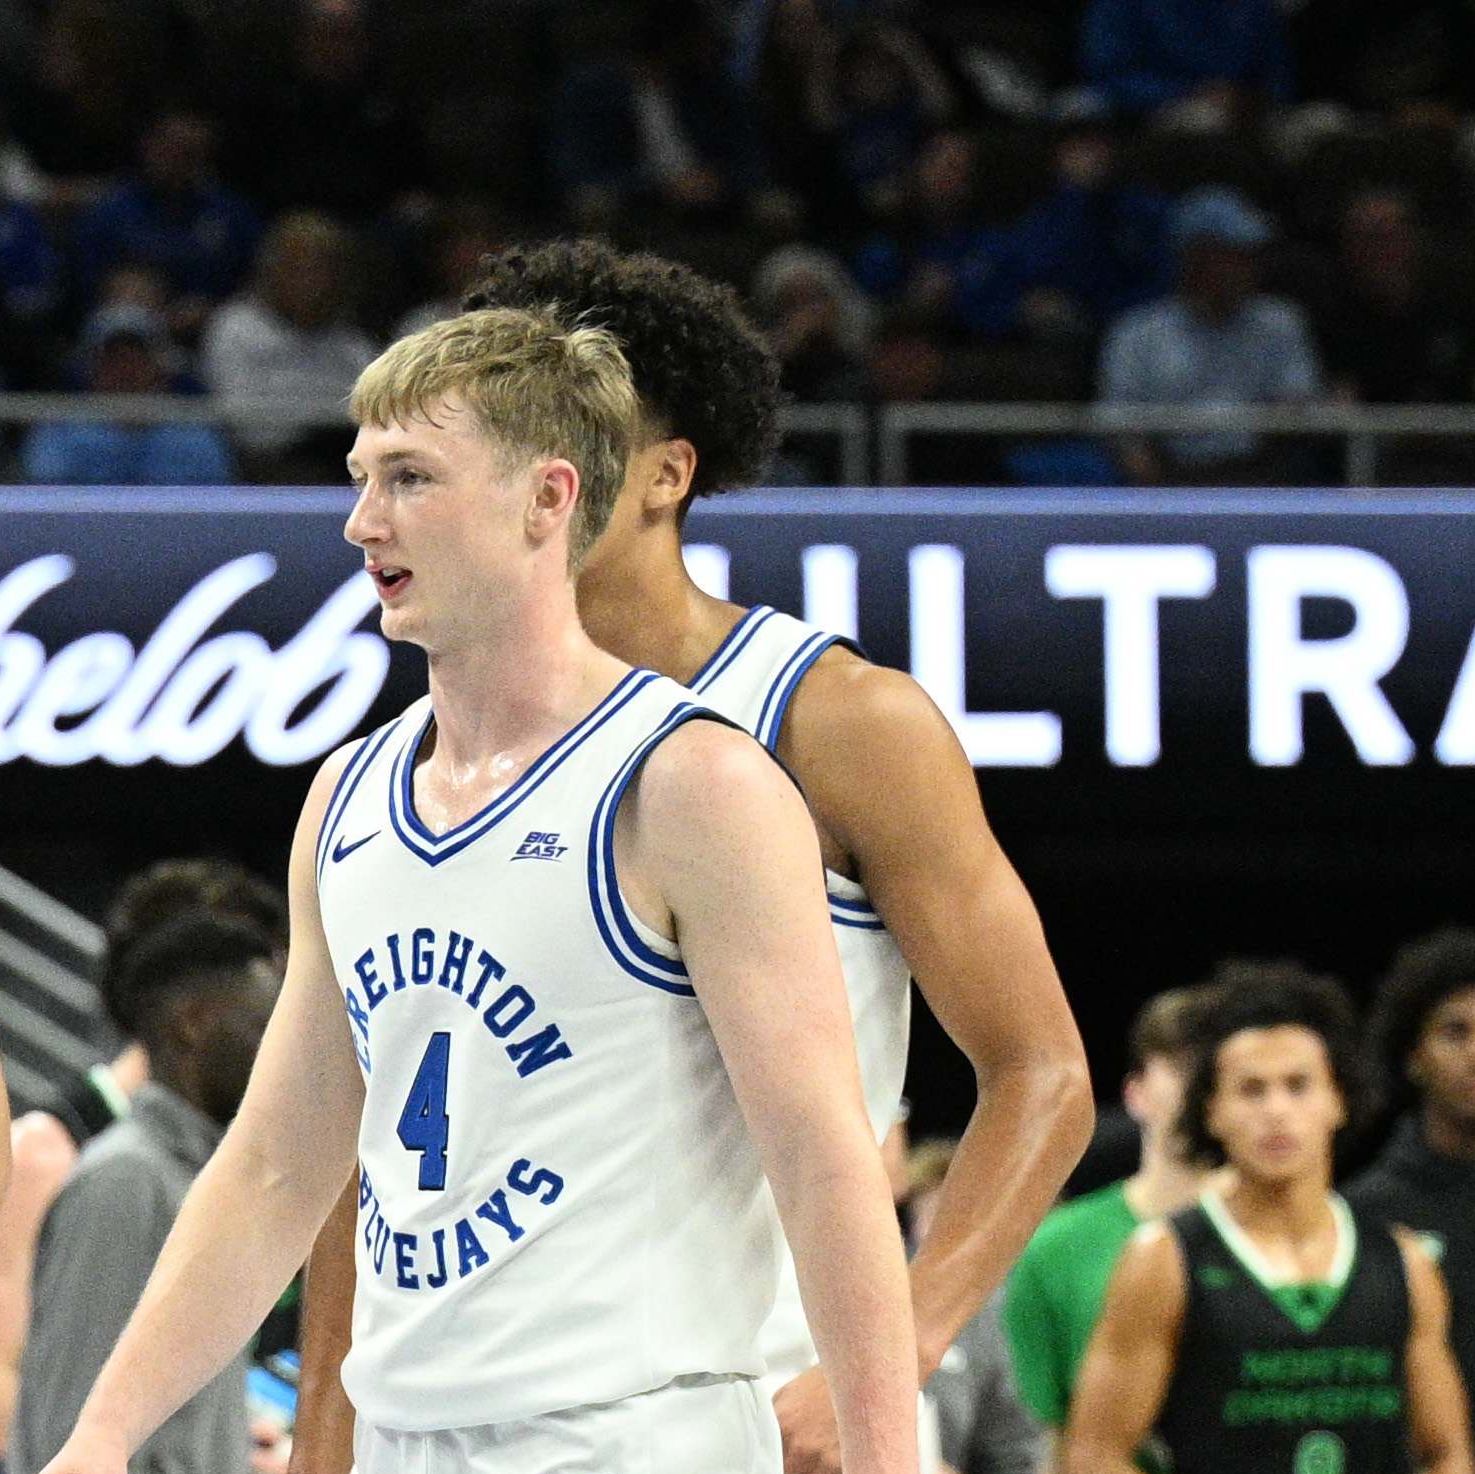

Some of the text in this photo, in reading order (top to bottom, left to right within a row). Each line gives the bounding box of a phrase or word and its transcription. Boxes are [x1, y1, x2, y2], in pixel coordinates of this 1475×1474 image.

[683, 544, 1475, 768] LTR
[515, 844, 569, 858] EAST
[523, 831, 561, 845] BIG
[396, 1030, 452, 1192] 4
